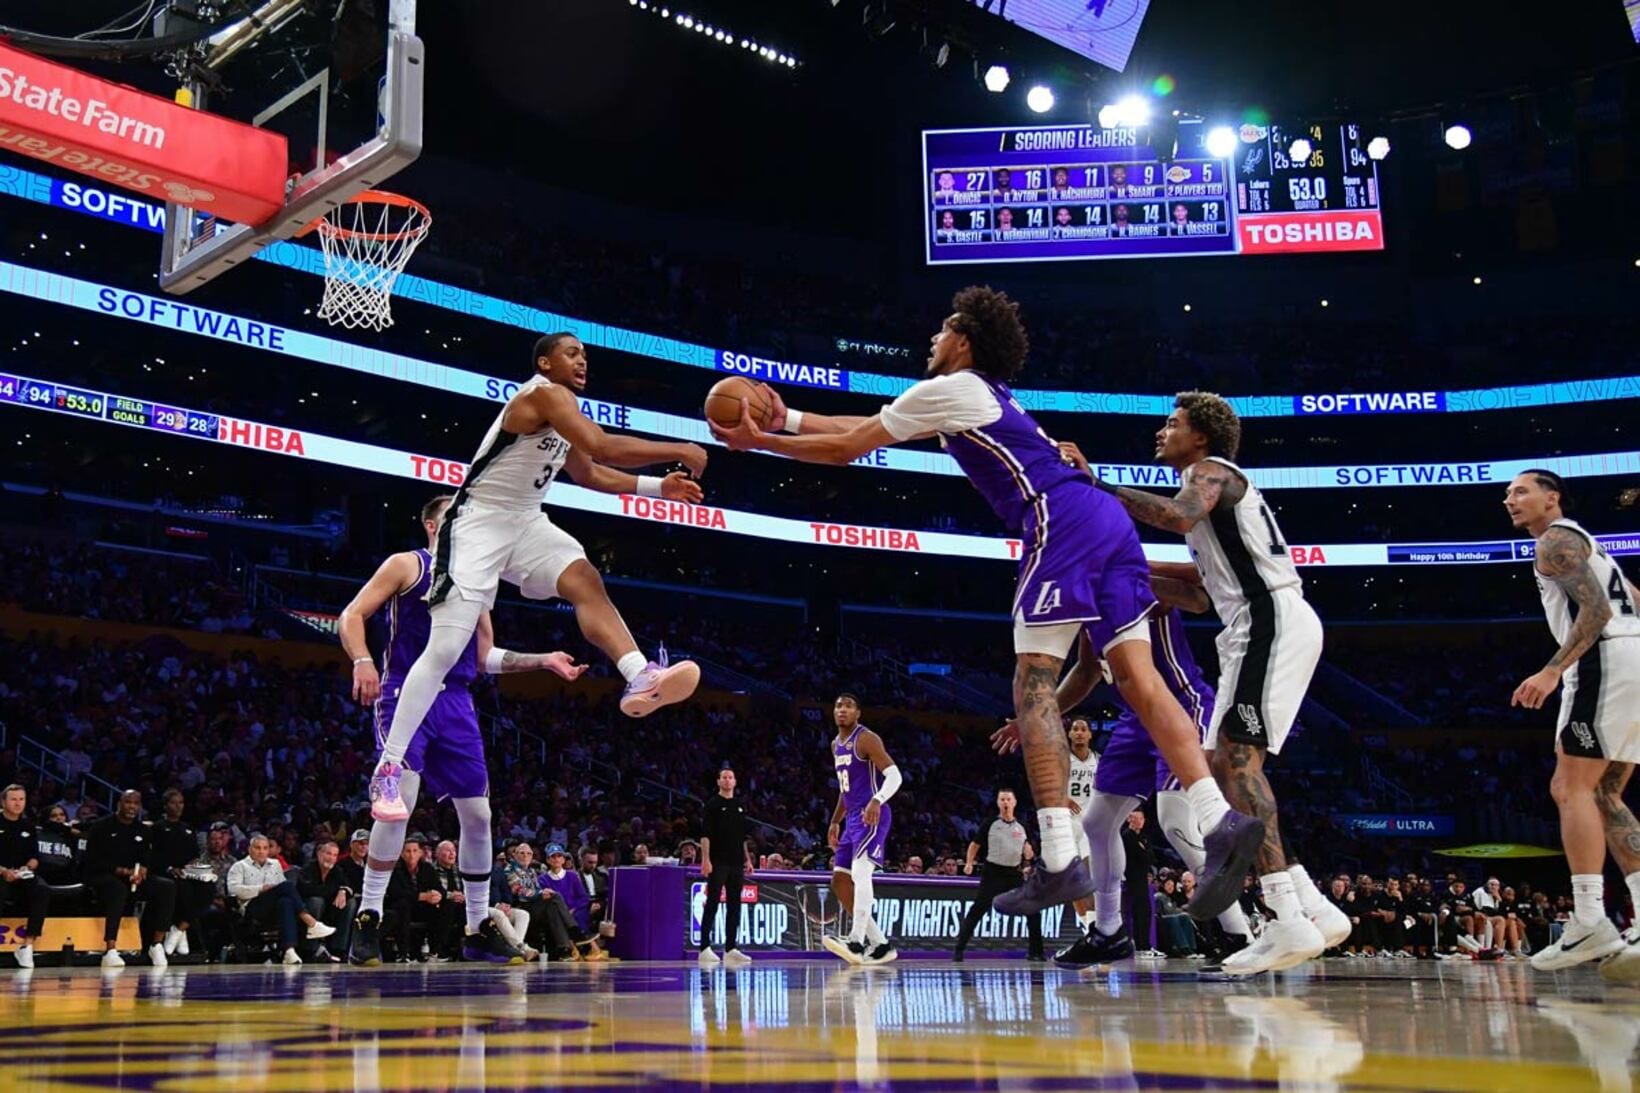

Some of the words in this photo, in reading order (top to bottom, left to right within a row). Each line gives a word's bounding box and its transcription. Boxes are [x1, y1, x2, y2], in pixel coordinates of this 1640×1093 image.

[1015, 131, 1076, 151] SCORING
[1078, 128, 1136, 148] LEADERS
[966, 173, 985, 191] 27
[1025, 170, 1042, 189] 16
[1085, 168, 1097, 187] 11
[1144, 166, 1154, 185] 9
[1203, 164, 1212, 182] 5
[1289, 178, 1326, 200] 53.0
[970, 211, 986, 229] 15
[1027, 209, 1043, 227] 14
[1085, 207, 1101, 225] 14
[1143, 205, 1160, 223] 14
[1202, 203, 1219, 221] 13
[1246, 221, 1374, 245] TOSHIBA
[97, 287, 286, 351] SOFTWARE
[1335, 463, 1493, 486] SOFTWARE
[721, 350, 841, 388] SOFTWARE
[1301, 391, 1438, 414] SOFTWARE
[30, 386, 51, 404] 94
[66, 394, 102, 413] 53.0
[116, 399, 144, 413] FIELD
[112, 411, 146, 426] GOALS
[156, 411, 176, 427] 29
[189, 417, 208, 432] 28
[534, 464, 553, 490] 3
[619, 493, 727, 530] TOSHIBA
[810, 522, 920, 551] TOSHIBA
[1409, 553, 1435, 563] Happy
[1456, 551, 1491, 562] Birthday
[1070, 782, 1091, 797] 24
[1396, 820, 1436, 831] ULTRA
[753, 903, 788, 945] CUP
[901, 898, 961, 937] NIGHTS
